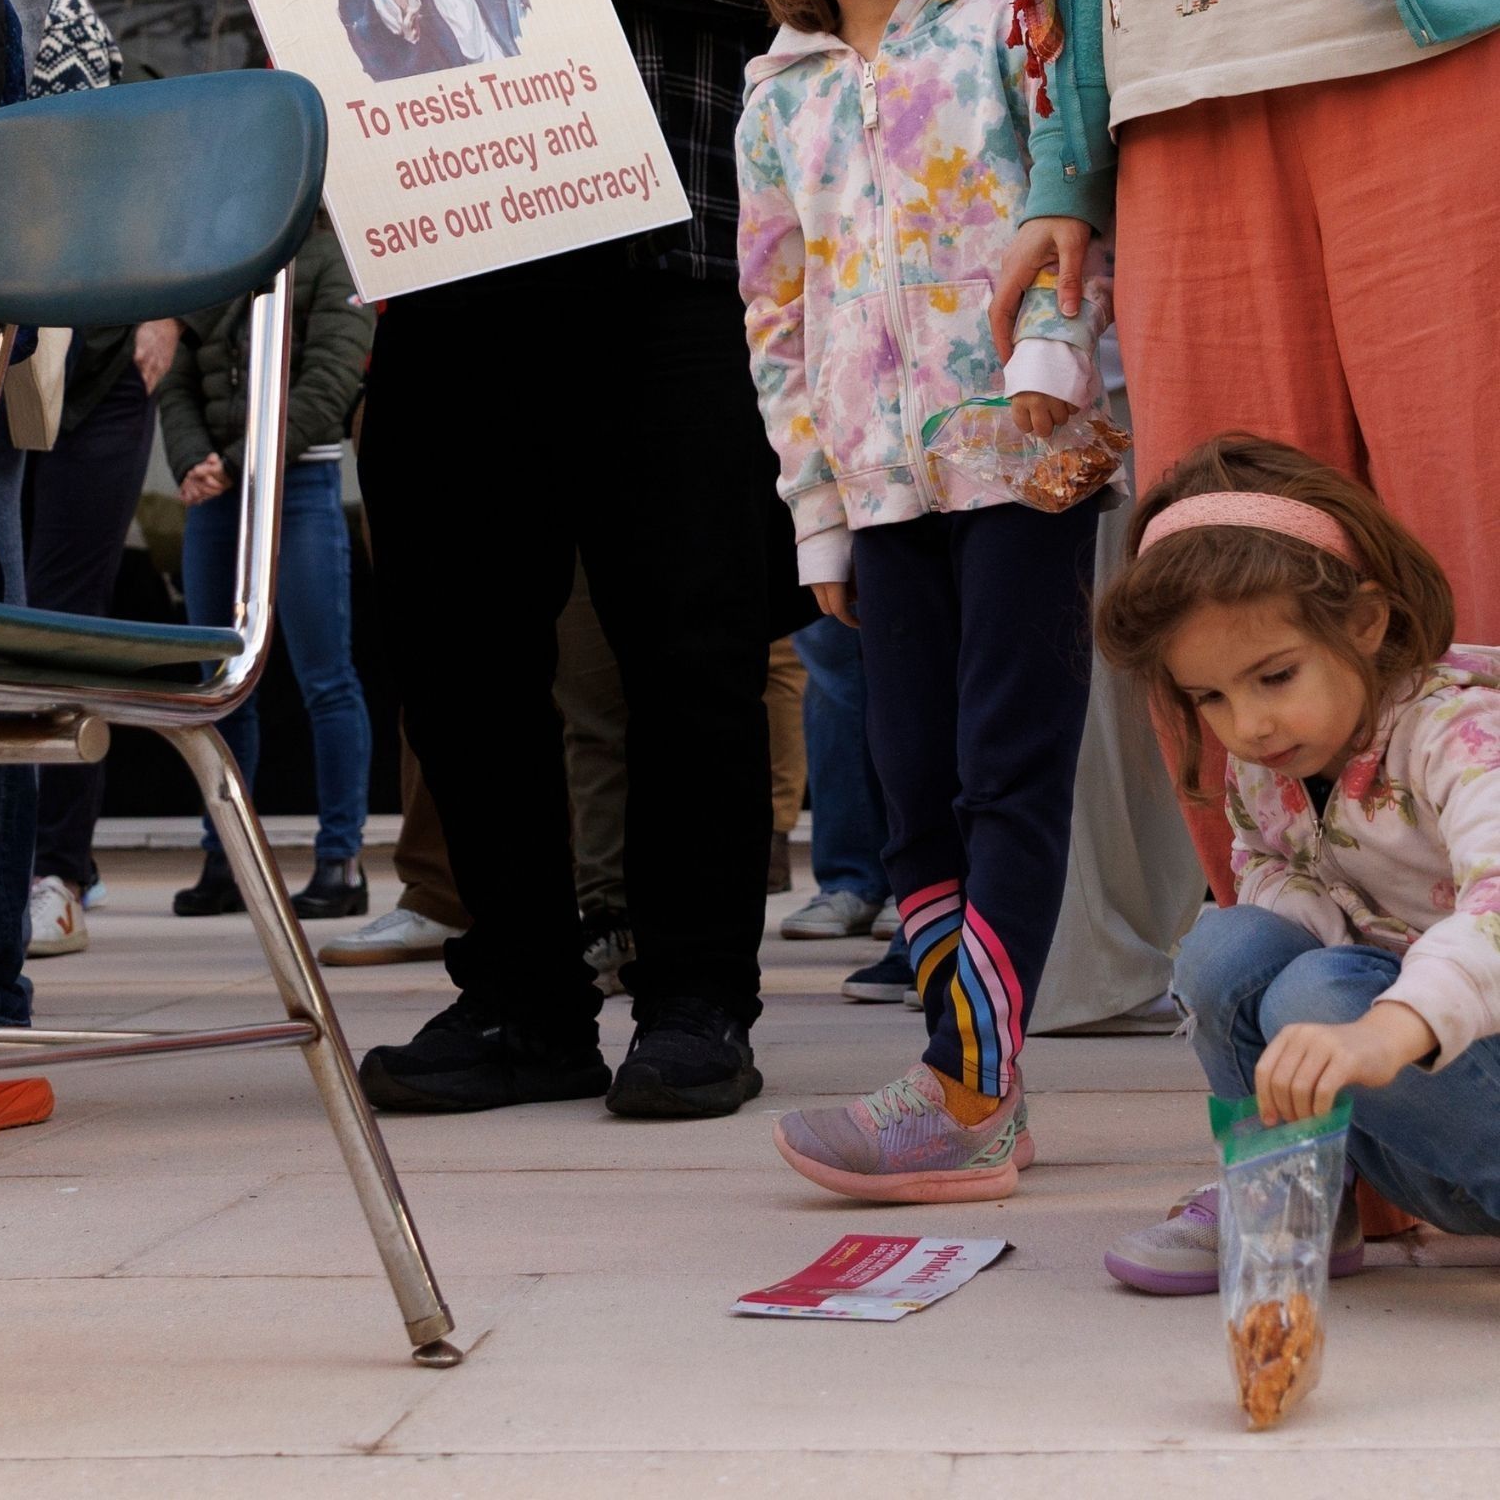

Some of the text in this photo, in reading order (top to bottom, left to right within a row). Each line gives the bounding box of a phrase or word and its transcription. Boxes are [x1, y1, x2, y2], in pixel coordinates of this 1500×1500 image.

[346, 58, 598, 139] To resist Trump's
[395, 110, 599, 191] autocracy and
[365, 152, 661, 259] save our democracy!
[900, 1243, 968, 1285] spindrift
